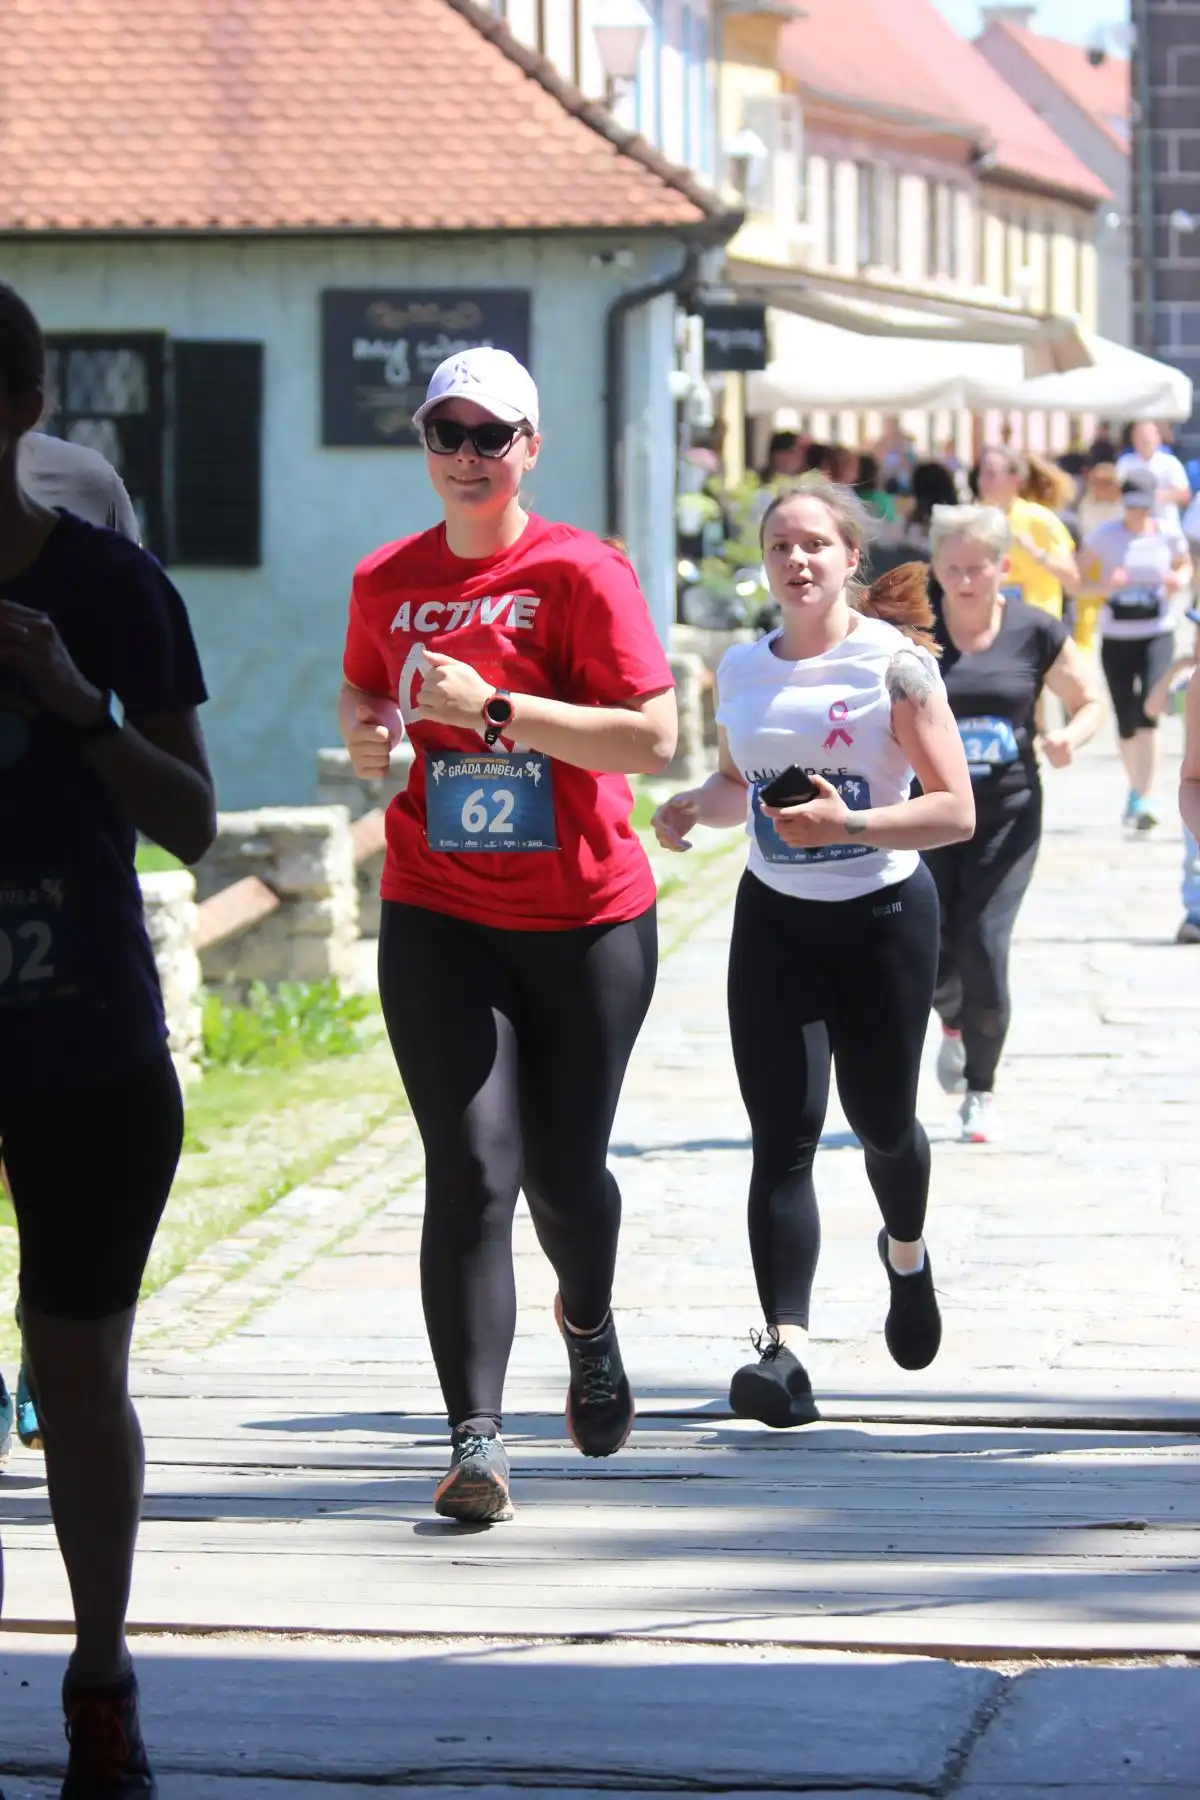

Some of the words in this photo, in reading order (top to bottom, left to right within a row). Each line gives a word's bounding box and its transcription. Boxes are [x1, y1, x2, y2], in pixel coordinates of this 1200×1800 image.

[390, 595, 540, 633] ACTIVE
[448, 763, 481, 778] GRADA
[461, 788, 515, 833] 62
